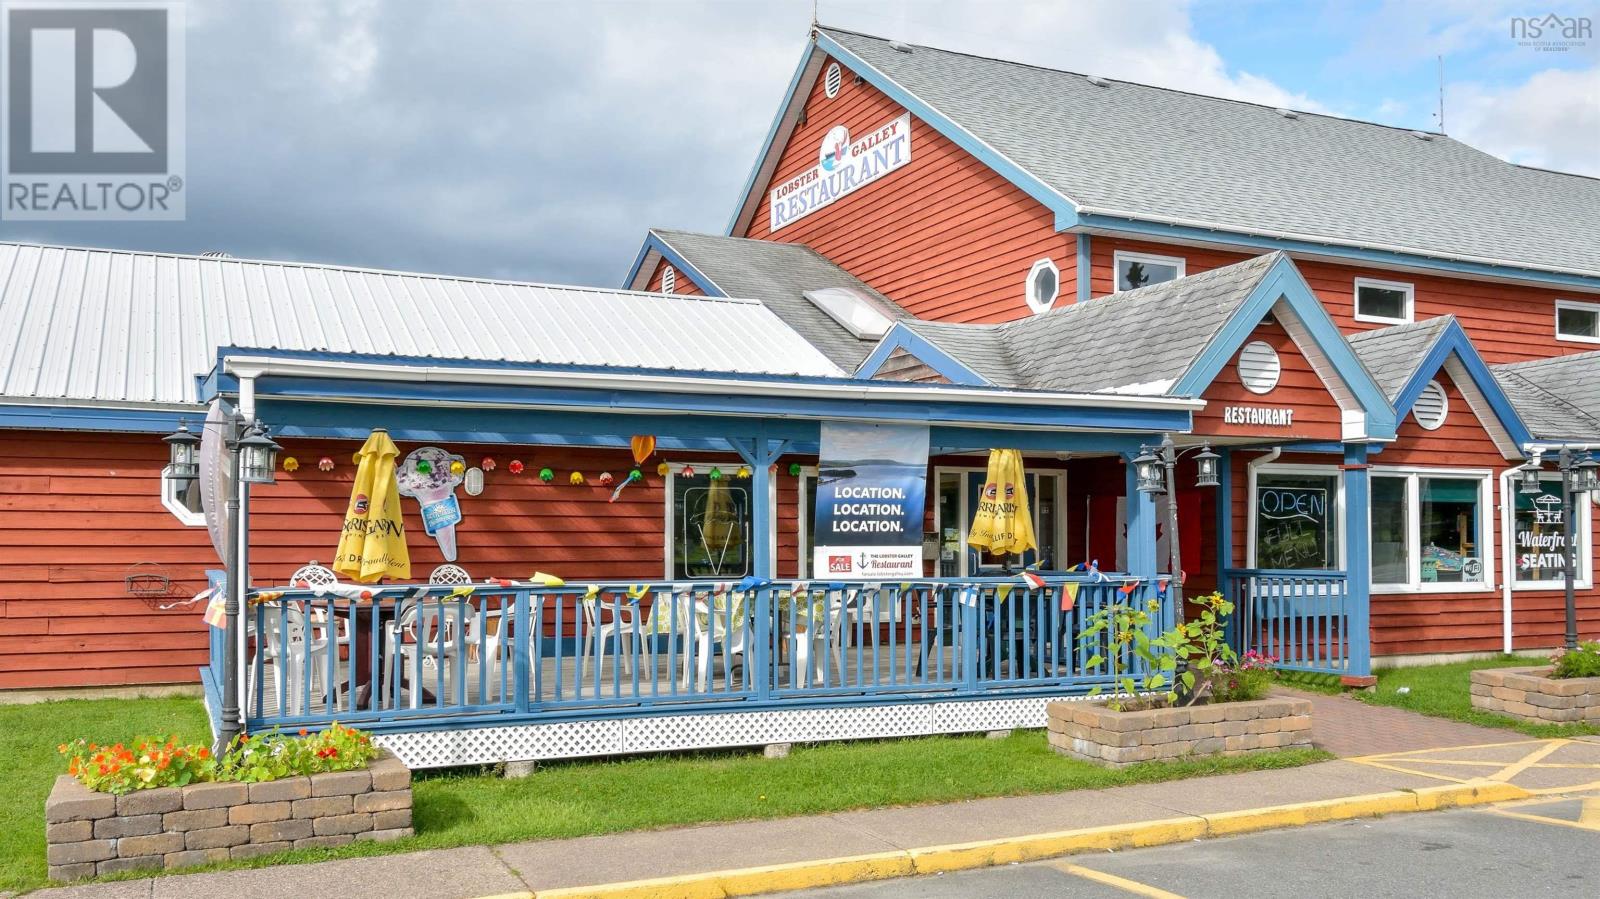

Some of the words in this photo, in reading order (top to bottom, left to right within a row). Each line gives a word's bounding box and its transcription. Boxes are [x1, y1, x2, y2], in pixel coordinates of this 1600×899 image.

[776, 168, 819, 200] LOBSTER
[851, 121, 899, 158] GALLEY
[774, 134, 905, 227] RESTAURANT
[1224, 406, 1294, 426] RESTAURANT
[834, 487, 906, 499] LOCATION.
[833, 503, 905, 515] LOCATION.
[1262, 490, 1324, 516] OPEN
[832, 520, 904, 532] LOCATION.
[1518, 531, 1577, 551] Waterfrot
[830, 563, 850, 571] SALE
[870, 560, 913, 569] Restaurant
